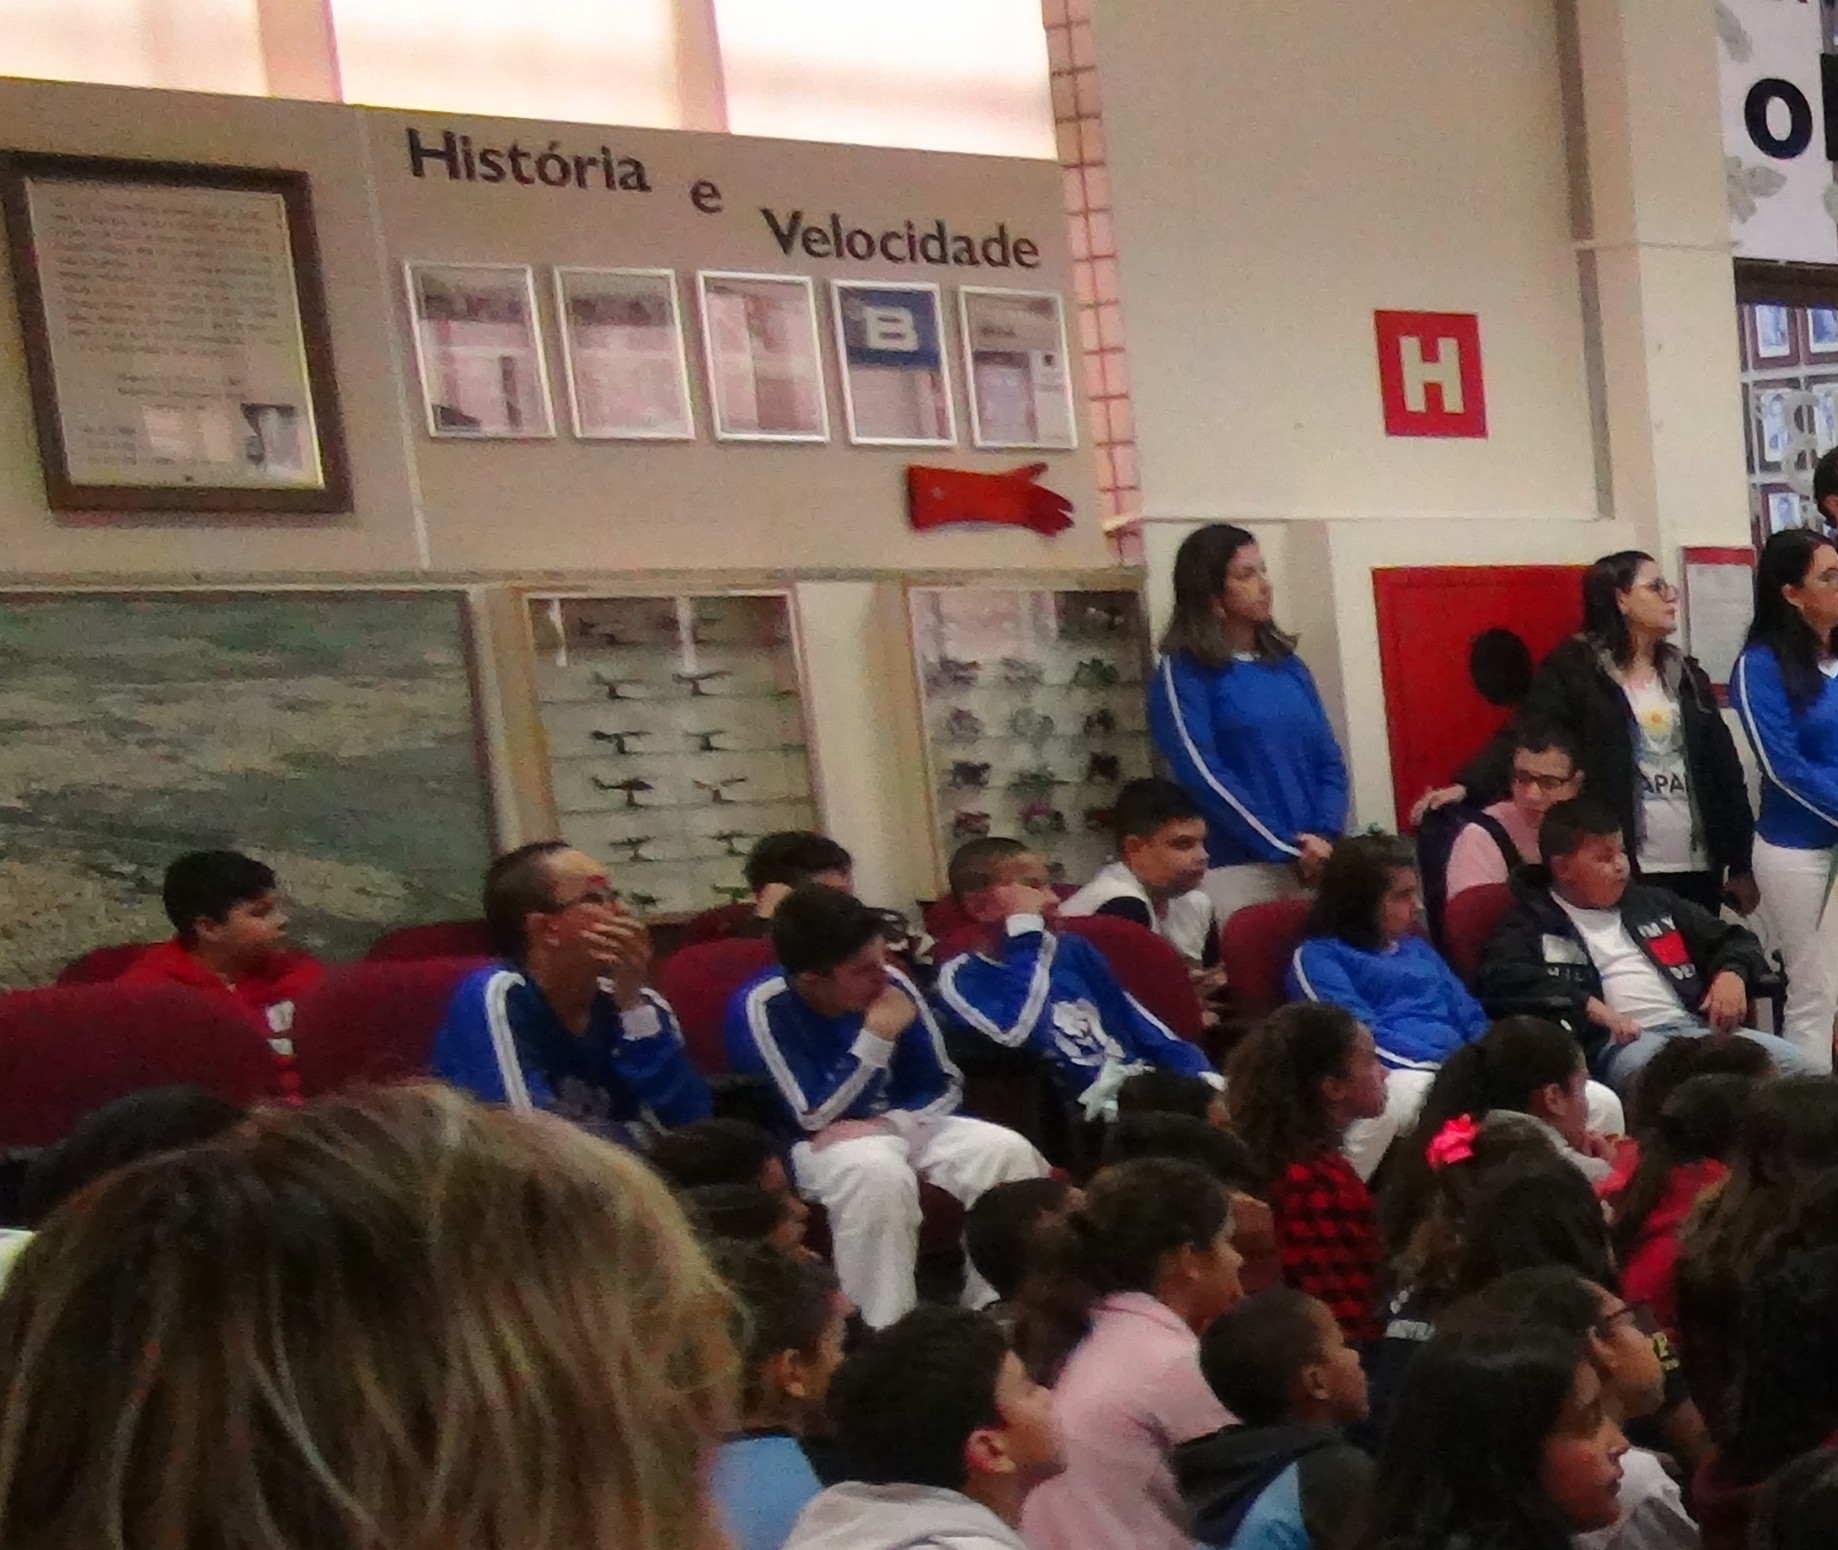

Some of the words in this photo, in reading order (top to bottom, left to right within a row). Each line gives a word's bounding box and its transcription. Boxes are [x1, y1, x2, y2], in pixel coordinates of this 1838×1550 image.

[406, 127, 652, 193] História
[690, 177, 723, 214] e
[760, 206, 1042, 270] Velocidade
[1398, 333, 1465, 415] H
[1639, 771, 1690, 794] APA
